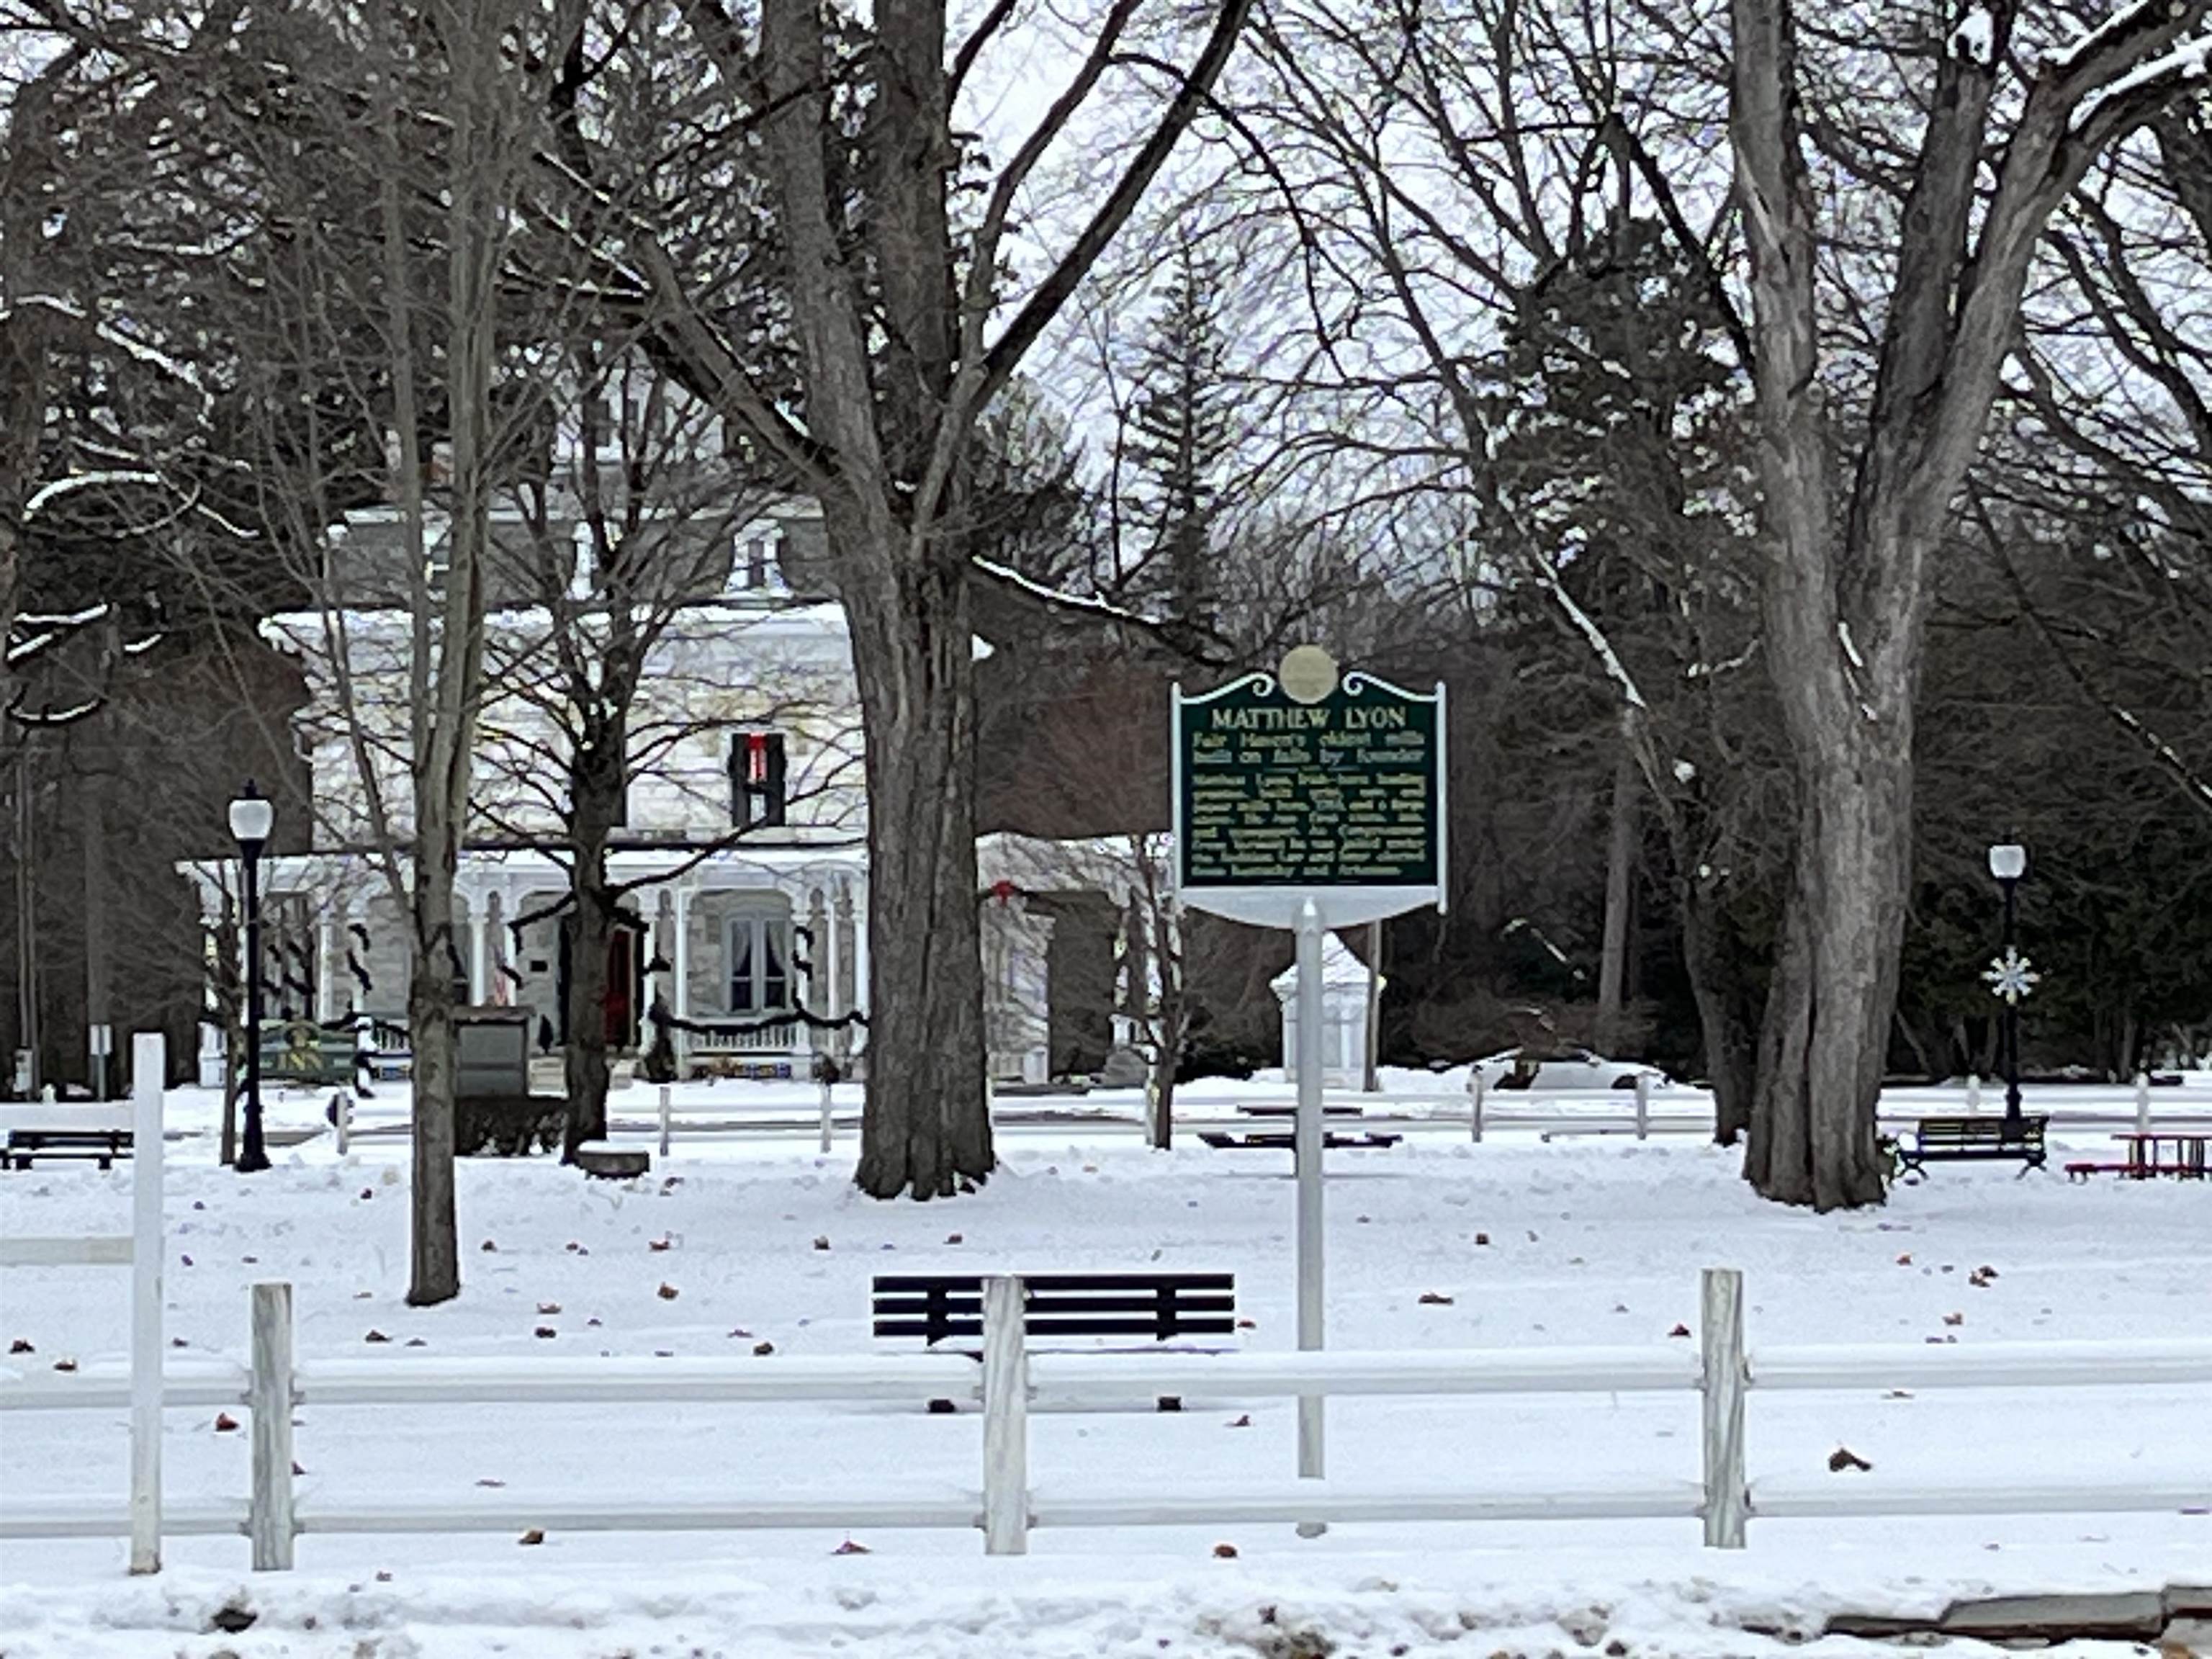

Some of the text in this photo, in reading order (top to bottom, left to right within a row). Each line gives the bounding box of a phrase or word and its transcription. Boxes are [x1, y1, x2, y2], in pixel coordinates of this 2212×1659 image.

[1212, 706, 1407, 729] MATTHEW LYON
[1319, 749, 1344, 765] by
